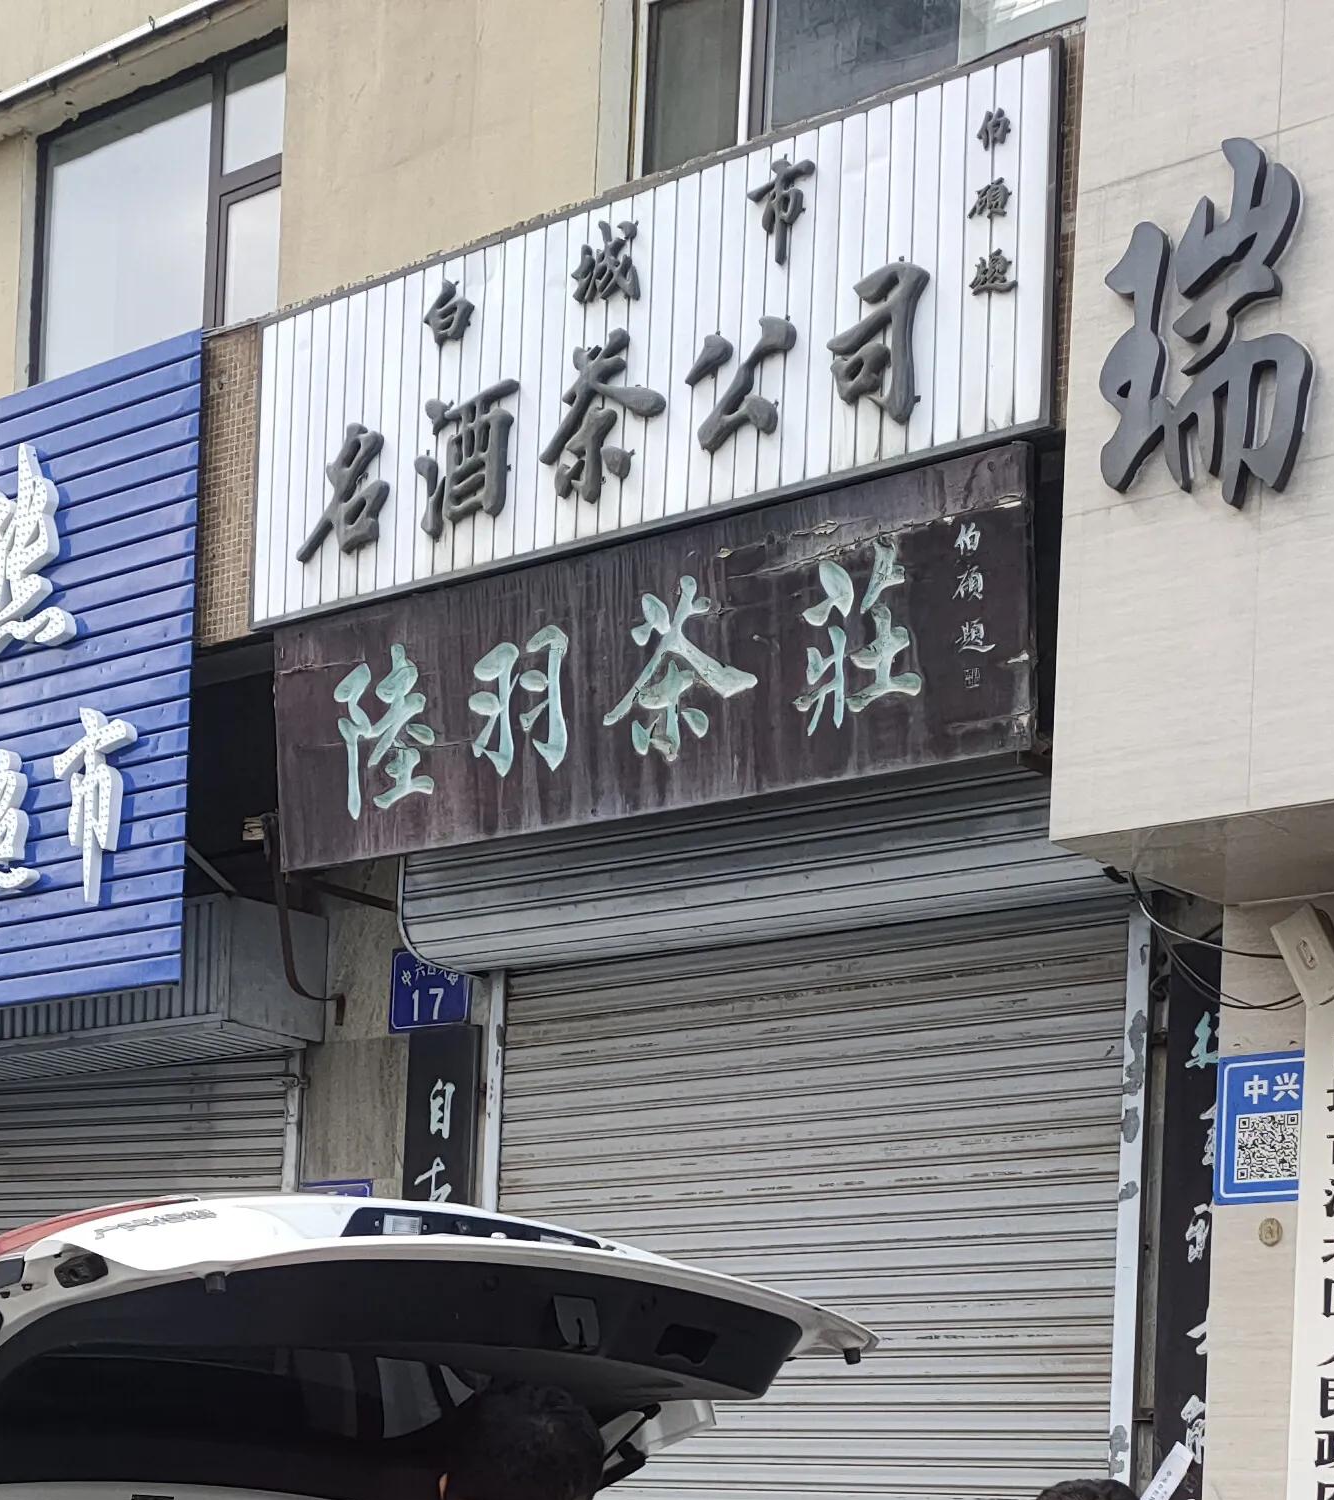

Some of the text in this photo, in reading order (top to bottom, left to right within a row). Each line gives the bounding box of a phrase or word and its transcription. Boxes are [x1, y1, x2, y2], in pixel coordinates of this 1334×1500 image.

[423, 155, 815, 345] 白城市
[298, 257, 930, 563] 名酒茶公司
[411, 987, 445, 1022] 17
[1244, 1072, 1301, 1105] 中兴
